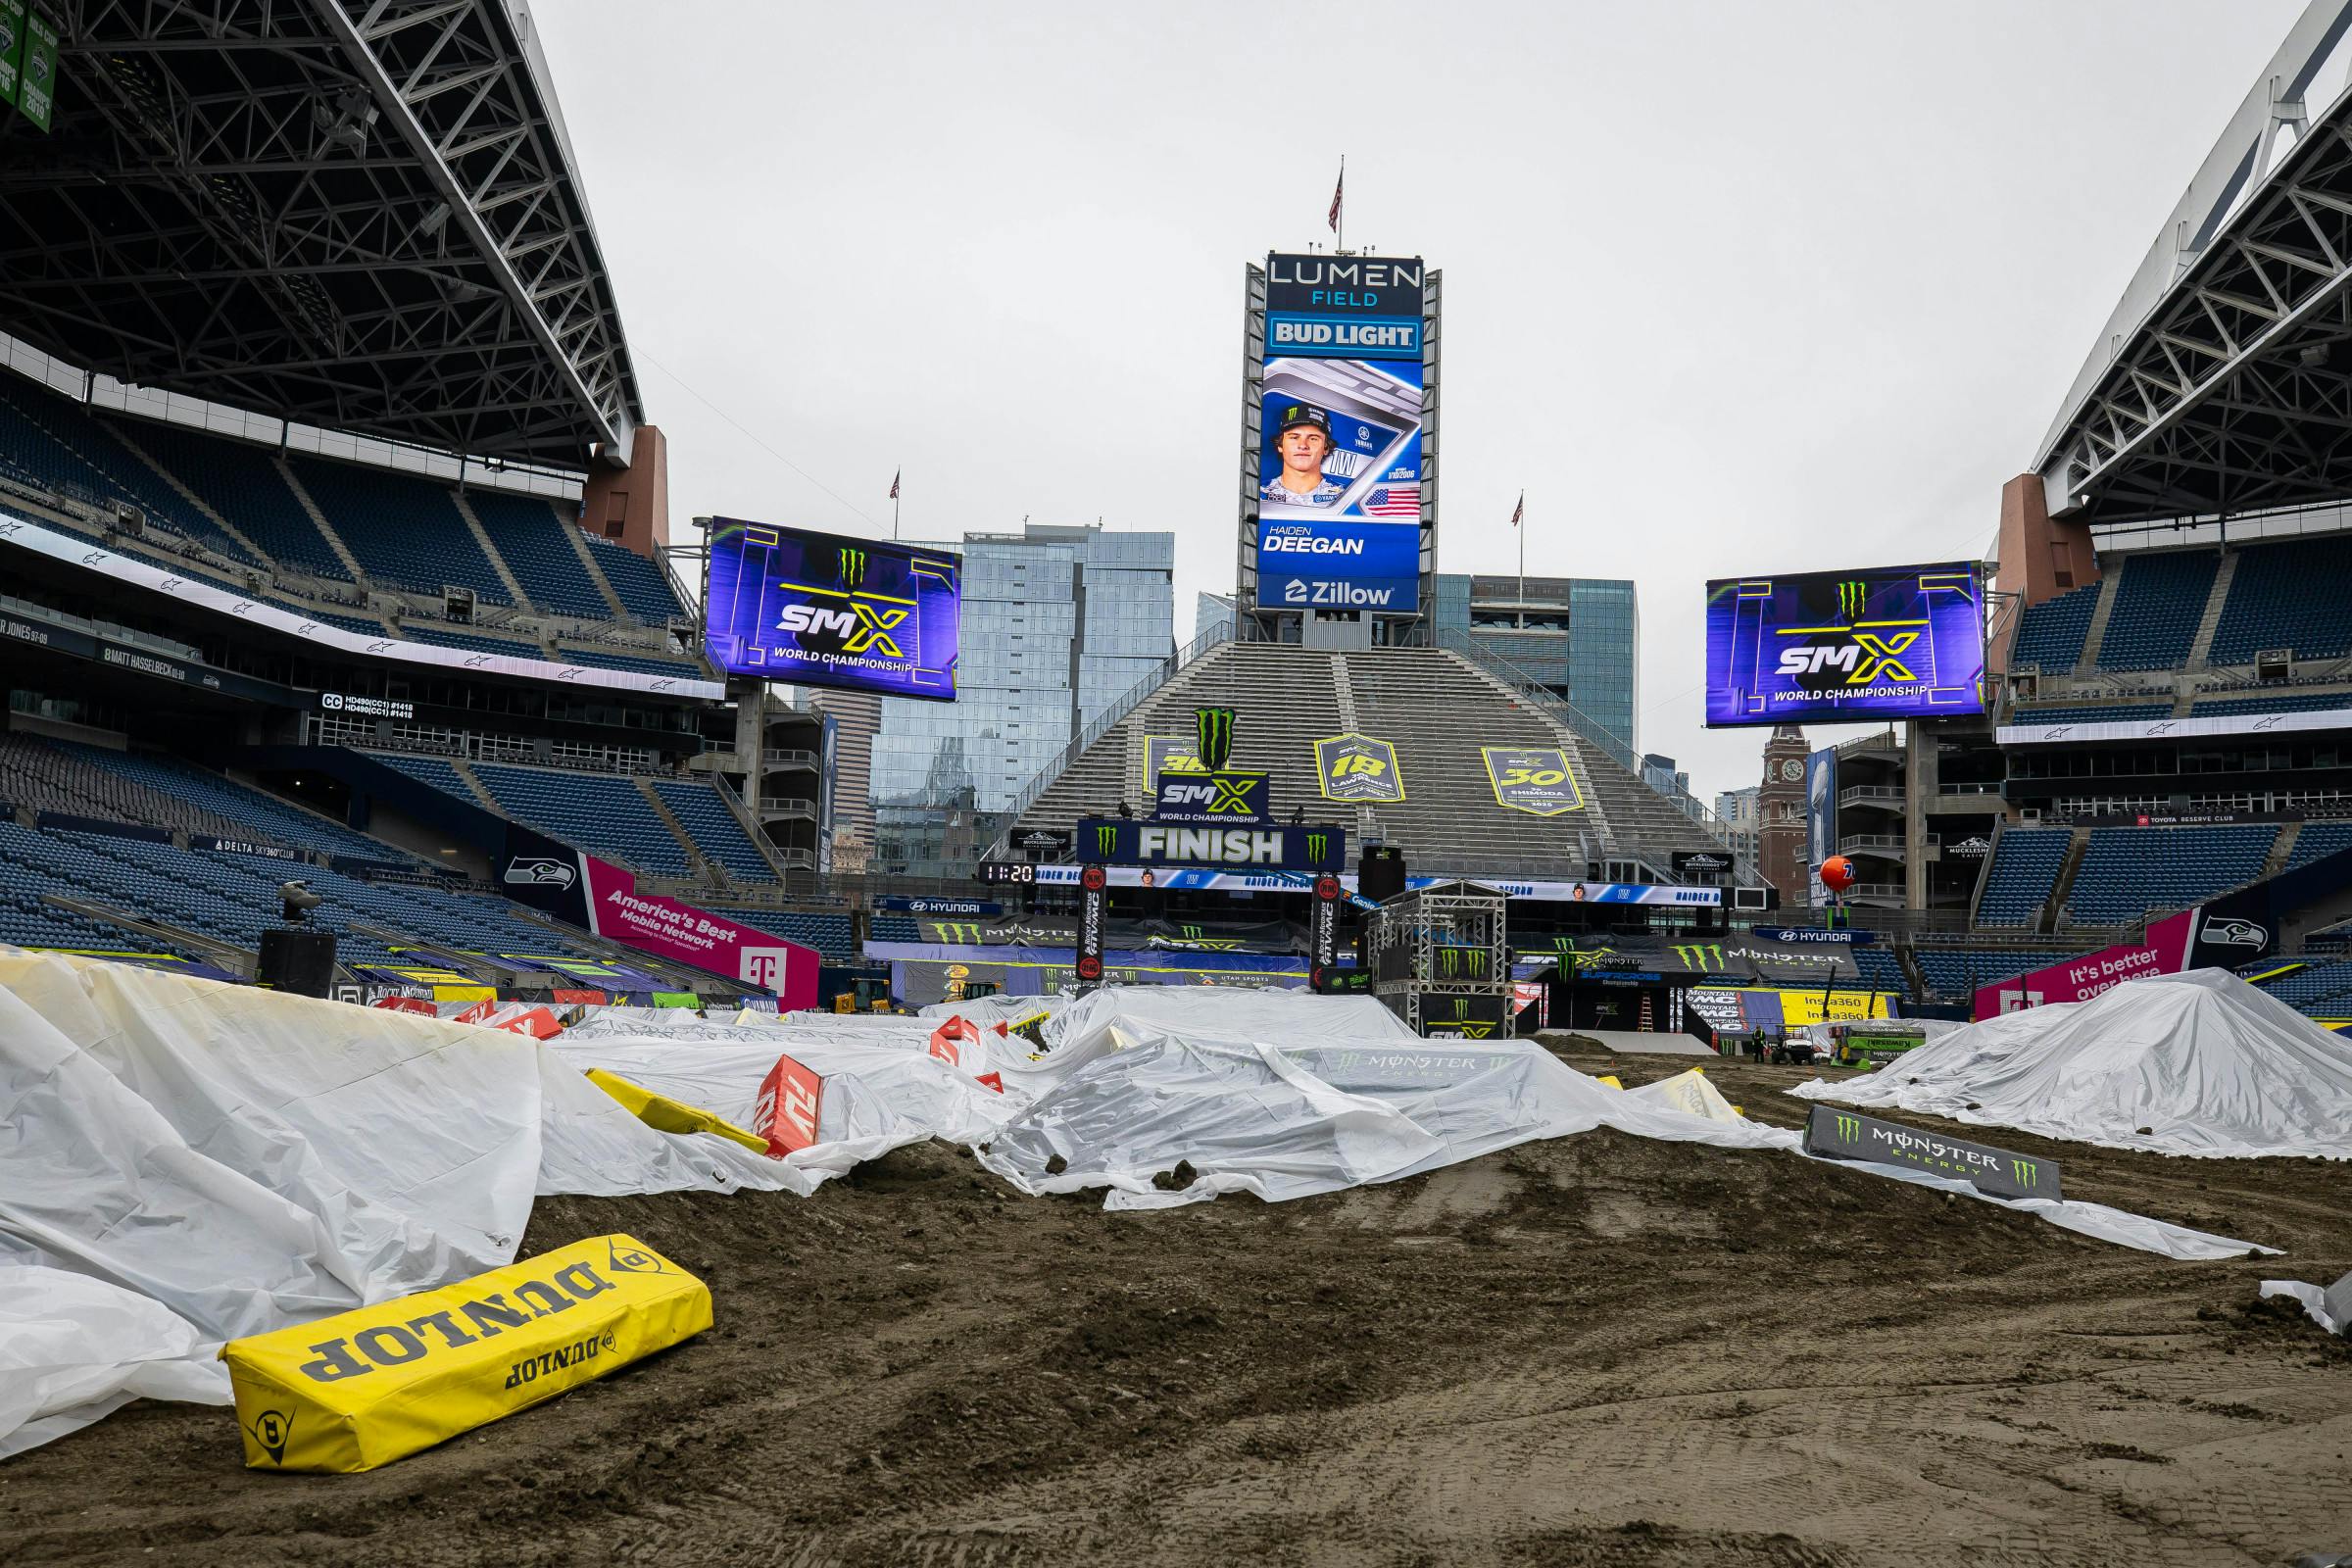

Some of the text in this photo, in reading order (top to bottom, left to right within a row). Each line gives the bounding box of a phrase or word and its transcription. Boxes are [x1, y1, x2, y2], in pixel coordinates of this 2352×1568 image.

[44, 28, 58, 47] CUP
[24, 77, 50, 110] CHAMPS
[26, 94, 45, 120] 2019
[1270, 261, 1421, 288] LUMEN
[1312, 290, 1378, 307] FIELD
[1276, 322, 1414, 346] BUD LIGHT
[1269, 525, 1312, 536] HAIDEN
[1262, 536, 1364, 555] DEEGAN
[447, 587, 470, 597] 343
[1311, 581, 1392, 606] Zillow
[7, 620, 31, 640] JONES
[775, 602, 909, 658] SMX
[104, 648, 111, 662] 8
[111, 649, 130, 666] MATT
[130, 654, 172, 677] HASSELBECK
[774, 647, 911, 673] WORLD CHAMPIONSHIP
[1774, 632, 1921, 684] SMX
[2009, 664, 2036, 674] 300
[323, 694, 342, 708] CC
[1774, 685, 1928, 702] WORLD CHAMPIONSHIP
[344, 704, 413, 719] HD490(CC1) #1418
[345, 696, 414, 711] HD490(CC1) #1418
[1331, 755, 1387, 777] 18
[1499, 768, 1565, 787] 30
[1160, 778, 1258, 814] SMX
[1159, 812, 1260, 823] WORLD CHAMPIONSHIP
[224, 840, 253, 853] DELTA
[1138, 826, 1284, 865] FINISH
[987, 864, 1032, 882] 11:20
[1245, 876, 1279, 888] HAIDEN
[1351, 895, 1376, 909] Genie
[1675, 891, 1710, 903] HAIDEN
[930, 902, 980, 912] HYUNDAI
[607, 889, 737, 944] America's Best
[619, 908, 716, 950] Mobile Network
[986, 923, 1077, 938] MONSTE
[1799, 932, 1851, 942] HYUNDAI
[1598, 956, 1644, 965] MONSTER
[2068, 947, 2160, 986] It's better
[1579, 971, 1662, 981] SUPERCROSS
[376, 985, 433, 1000] ROCKY MOUNTAIN
[1804, 996, 1861, 1007] Insa360
[1807, 1010, 1864, 1021] Insa360
[1867, 1039, 1911, 1049] Kawasaki
[1367, 1054, 1477, 1070] MONSTER
[1871, 1127, 2001, 1172] MONSTER
[1891, 1148, 1982, 1176] ENERGY
[299, 1260, 617, 1383] DUNLOP
[504, 1335, 599, 1390] DUNLOP
